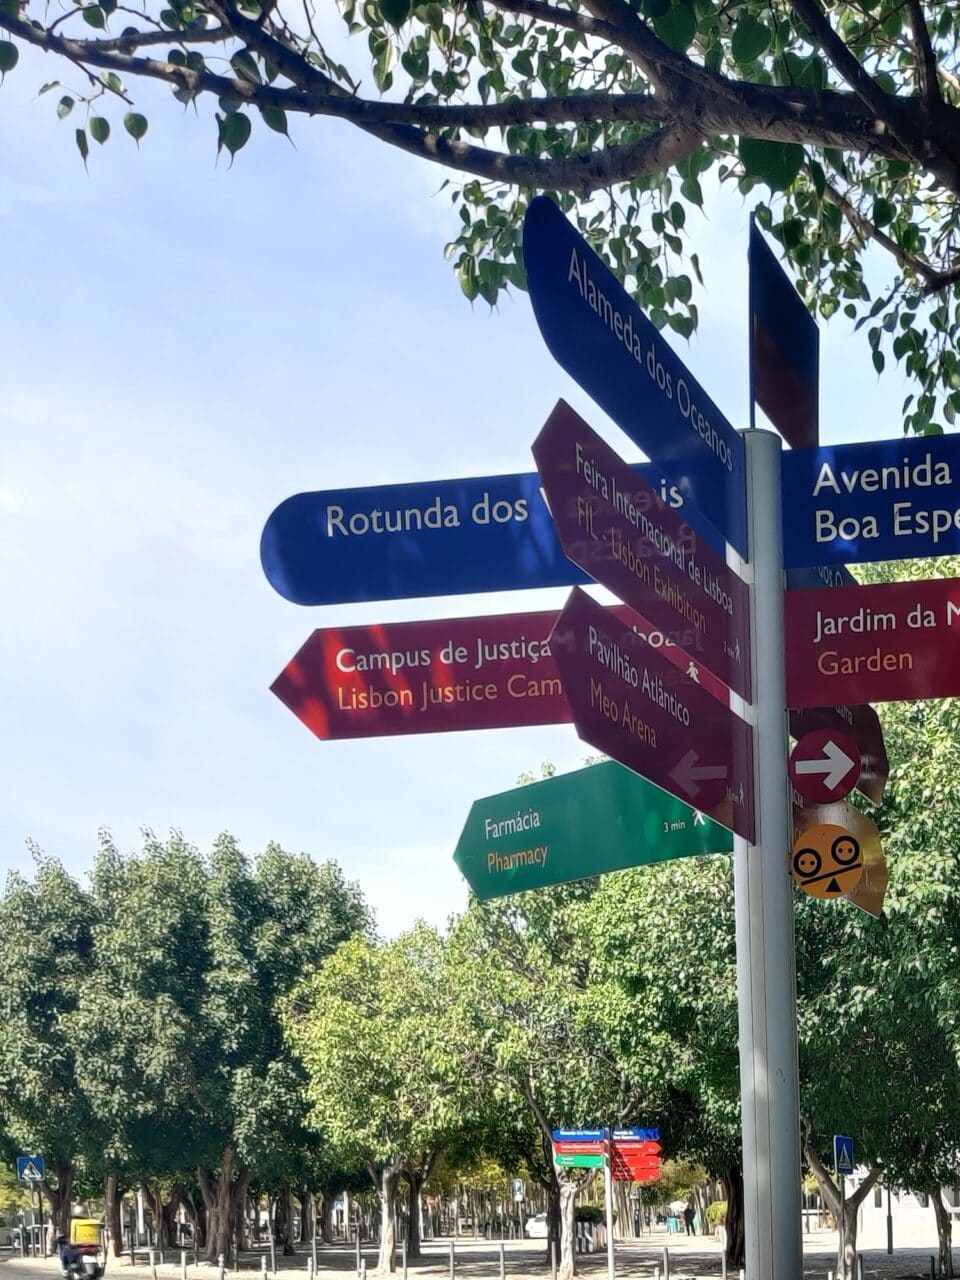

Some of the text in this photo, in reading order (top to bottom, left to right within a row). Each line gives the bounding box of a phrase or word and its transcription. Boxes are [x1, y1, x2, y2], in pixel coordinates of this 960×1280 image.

[568, 249, 734, 472] Alameda dos Oceanos
[812, 453, 952, 496] Avenida
[326, 493, 529, 537] Rotunda dos
[575, 442, 608, 498] Feira
[612, 478, 685, 570] Internacional
[688, 559, 701, 584] de
[703, 566, 733, 616] Lisboa
[815, 509, 879, 543] Boa
[577, 496, 598, 541] FIL
[611, 527, 650, 586] Lisbon
[654, 567, 706, 634] Exhibition
[813, 602, 897, 643] Jardim
[907, 603, 936, 628] da
[335, 637, 552, 675] Campus de Justiça
[588, 625, 639, 688] Pavilhão
[641, 668, 690, 727] Atlântico
[817, 649, 913, 676] Garden
[338, 674, 562, 711] Lisbon Justice Cam
[590, 677, 657, 749] Meo Arena
[485, 808, 540, 840] Farmácia
[663, 820, 686, 832] 3 min
[487, 845, 548, 874] Pharmacy
